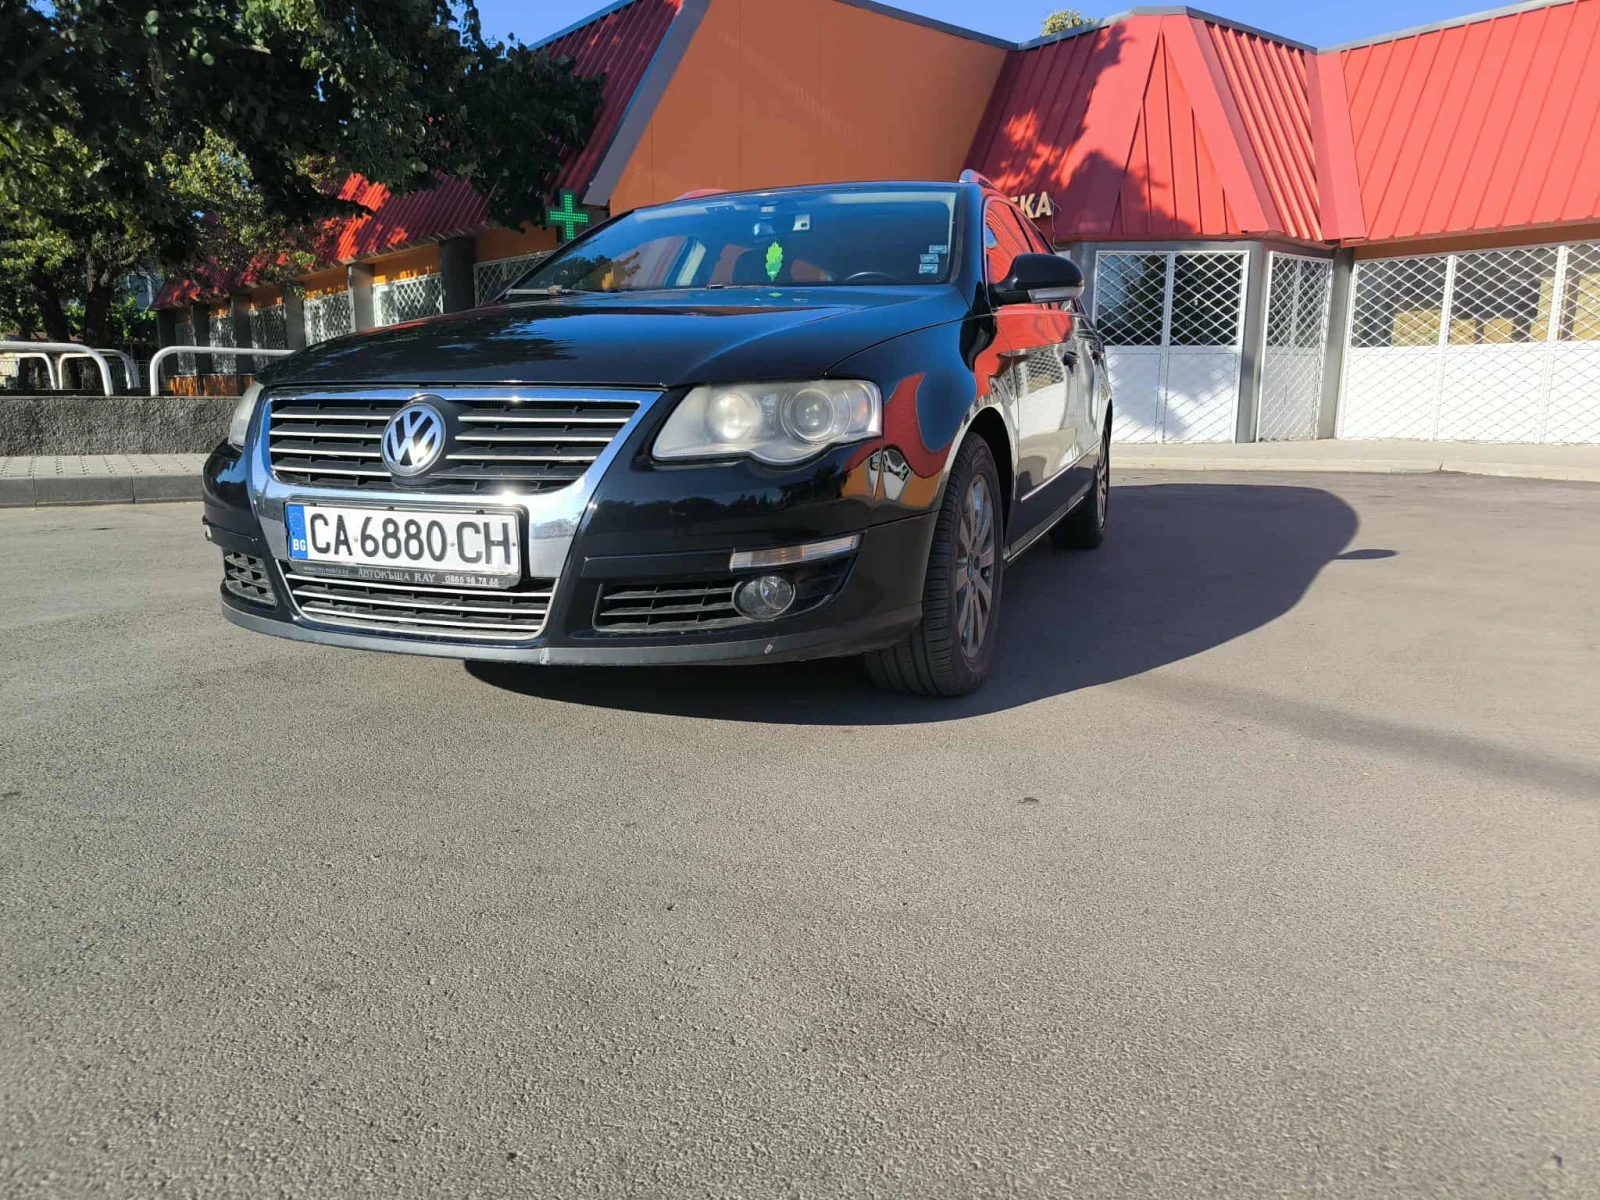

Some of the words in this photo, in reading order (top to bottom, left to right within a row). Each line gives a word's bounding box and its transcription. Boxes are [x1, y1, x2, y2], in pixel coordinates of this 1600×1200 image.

[1009, 191, 1052, 218] КА
[383, 406, 443, 470] VW
[292, 538, 306, 551] BG
[310, 513, 353, 556] CA
[360, 516, 448, 562] 6880
[456, 521, 511, 565] CH
[414, 573, 436, 582] RAY
